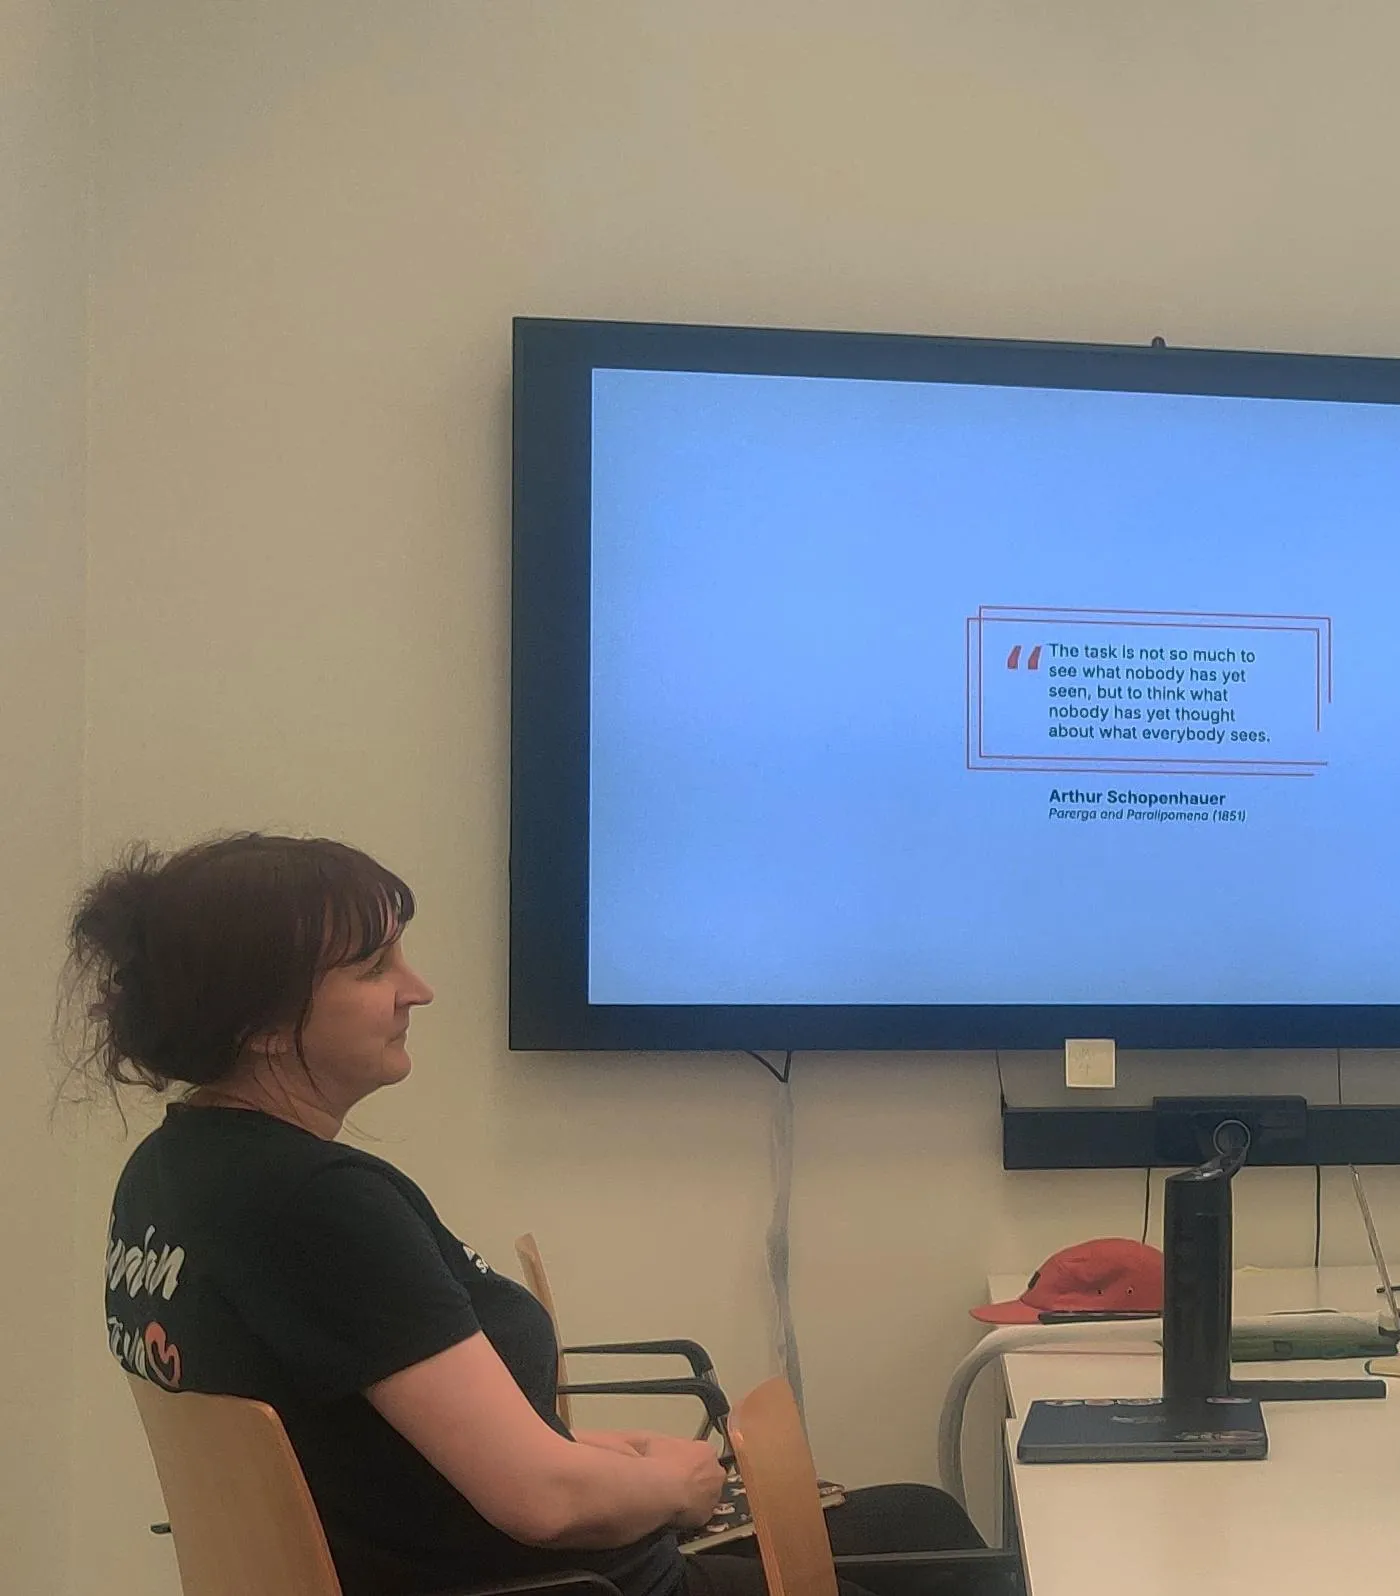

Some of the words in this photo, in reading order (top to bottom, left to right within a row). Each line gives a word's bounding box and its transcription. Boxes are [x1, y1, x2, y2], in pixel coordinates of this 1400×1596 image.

[1050, 643, 1079, 658] The
[1085, 644, 1118, 659] task
[1122, 645, 1134, 660] is
[1139, 647, 1165, 661] not
[1169, 650, 1188, 661] so
[1194, 648, 1236, 663] much
[1241, 649, 1256, 663] to
[1049, 665, 1077, 678] see
[1081, 664, 1121, 680] what
[1125, 665, 1184, 684] nobody
[1190, 668, 1217, 682] has
[1222, 669, 1246, 686] yet
[1049, 685, 1092, 701] seen,
[1097, 684, 1122, 700] but
[1127, 685, 1143, 700] to
[1147, 686, 1186, 701] think
[1190, 687, 1228, 702] what
[1049, 703, 1109, 722] nobody
[1114, 704, 1141, 720] has
[1146, 707, 1170, 724] yet
[1175, 706, 1236, 725] thought
[1049, 723, 1094, 740] about
[1099, 724, 1137, 740] what
[1142, 726, 1225, 744] everybody
[1230, 729, 1271, 743] sees.
[1049, 788, 1102, 804] Arthur
[1106, 789, 1226, 807] Schopenhauer
[1048, 807, 1097, 822] Parerga
[1100, 808, 1123, 820] and
[1126, 808, 1209, 823] Paralipomena
[1212, 809, 1246, 823] (1851)
